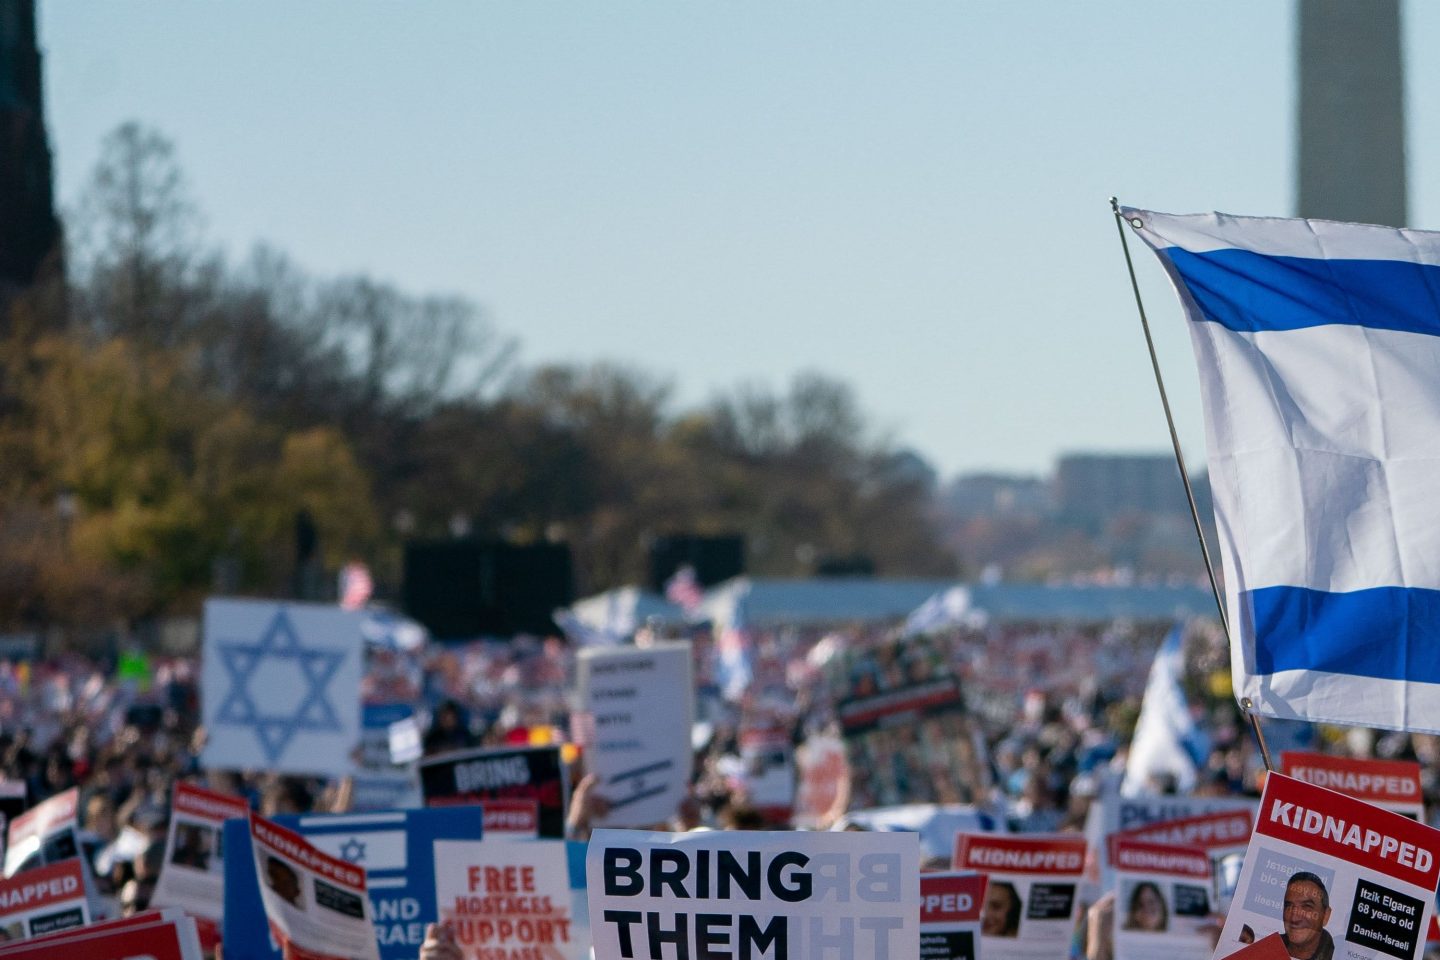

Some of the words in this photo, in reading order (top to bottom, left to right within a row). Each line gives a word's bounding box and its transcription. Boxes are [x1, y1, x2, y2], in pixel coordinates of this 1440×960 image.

[454, 756, 531, 793] BRING
[1269, 799, 1434, 874] KIDNAPPED
[255, 821, 362, 884] KIDNAPPED
[970, 850, 1081, 869] KIDNAPPED
[468, 866, 535, 892] FREE
[603, 847, 813, 902] BRING
[1357, 902, 1370, 915] 68
[1371, 908, 1397, 925] years
[1398, 917, 1415, 931] old
[1360, 888, 1381, 904] Itzik
[1382, 895, 1416, 917] Elgarat
[1353, 923, 1410, 951] Danish-Israeli
